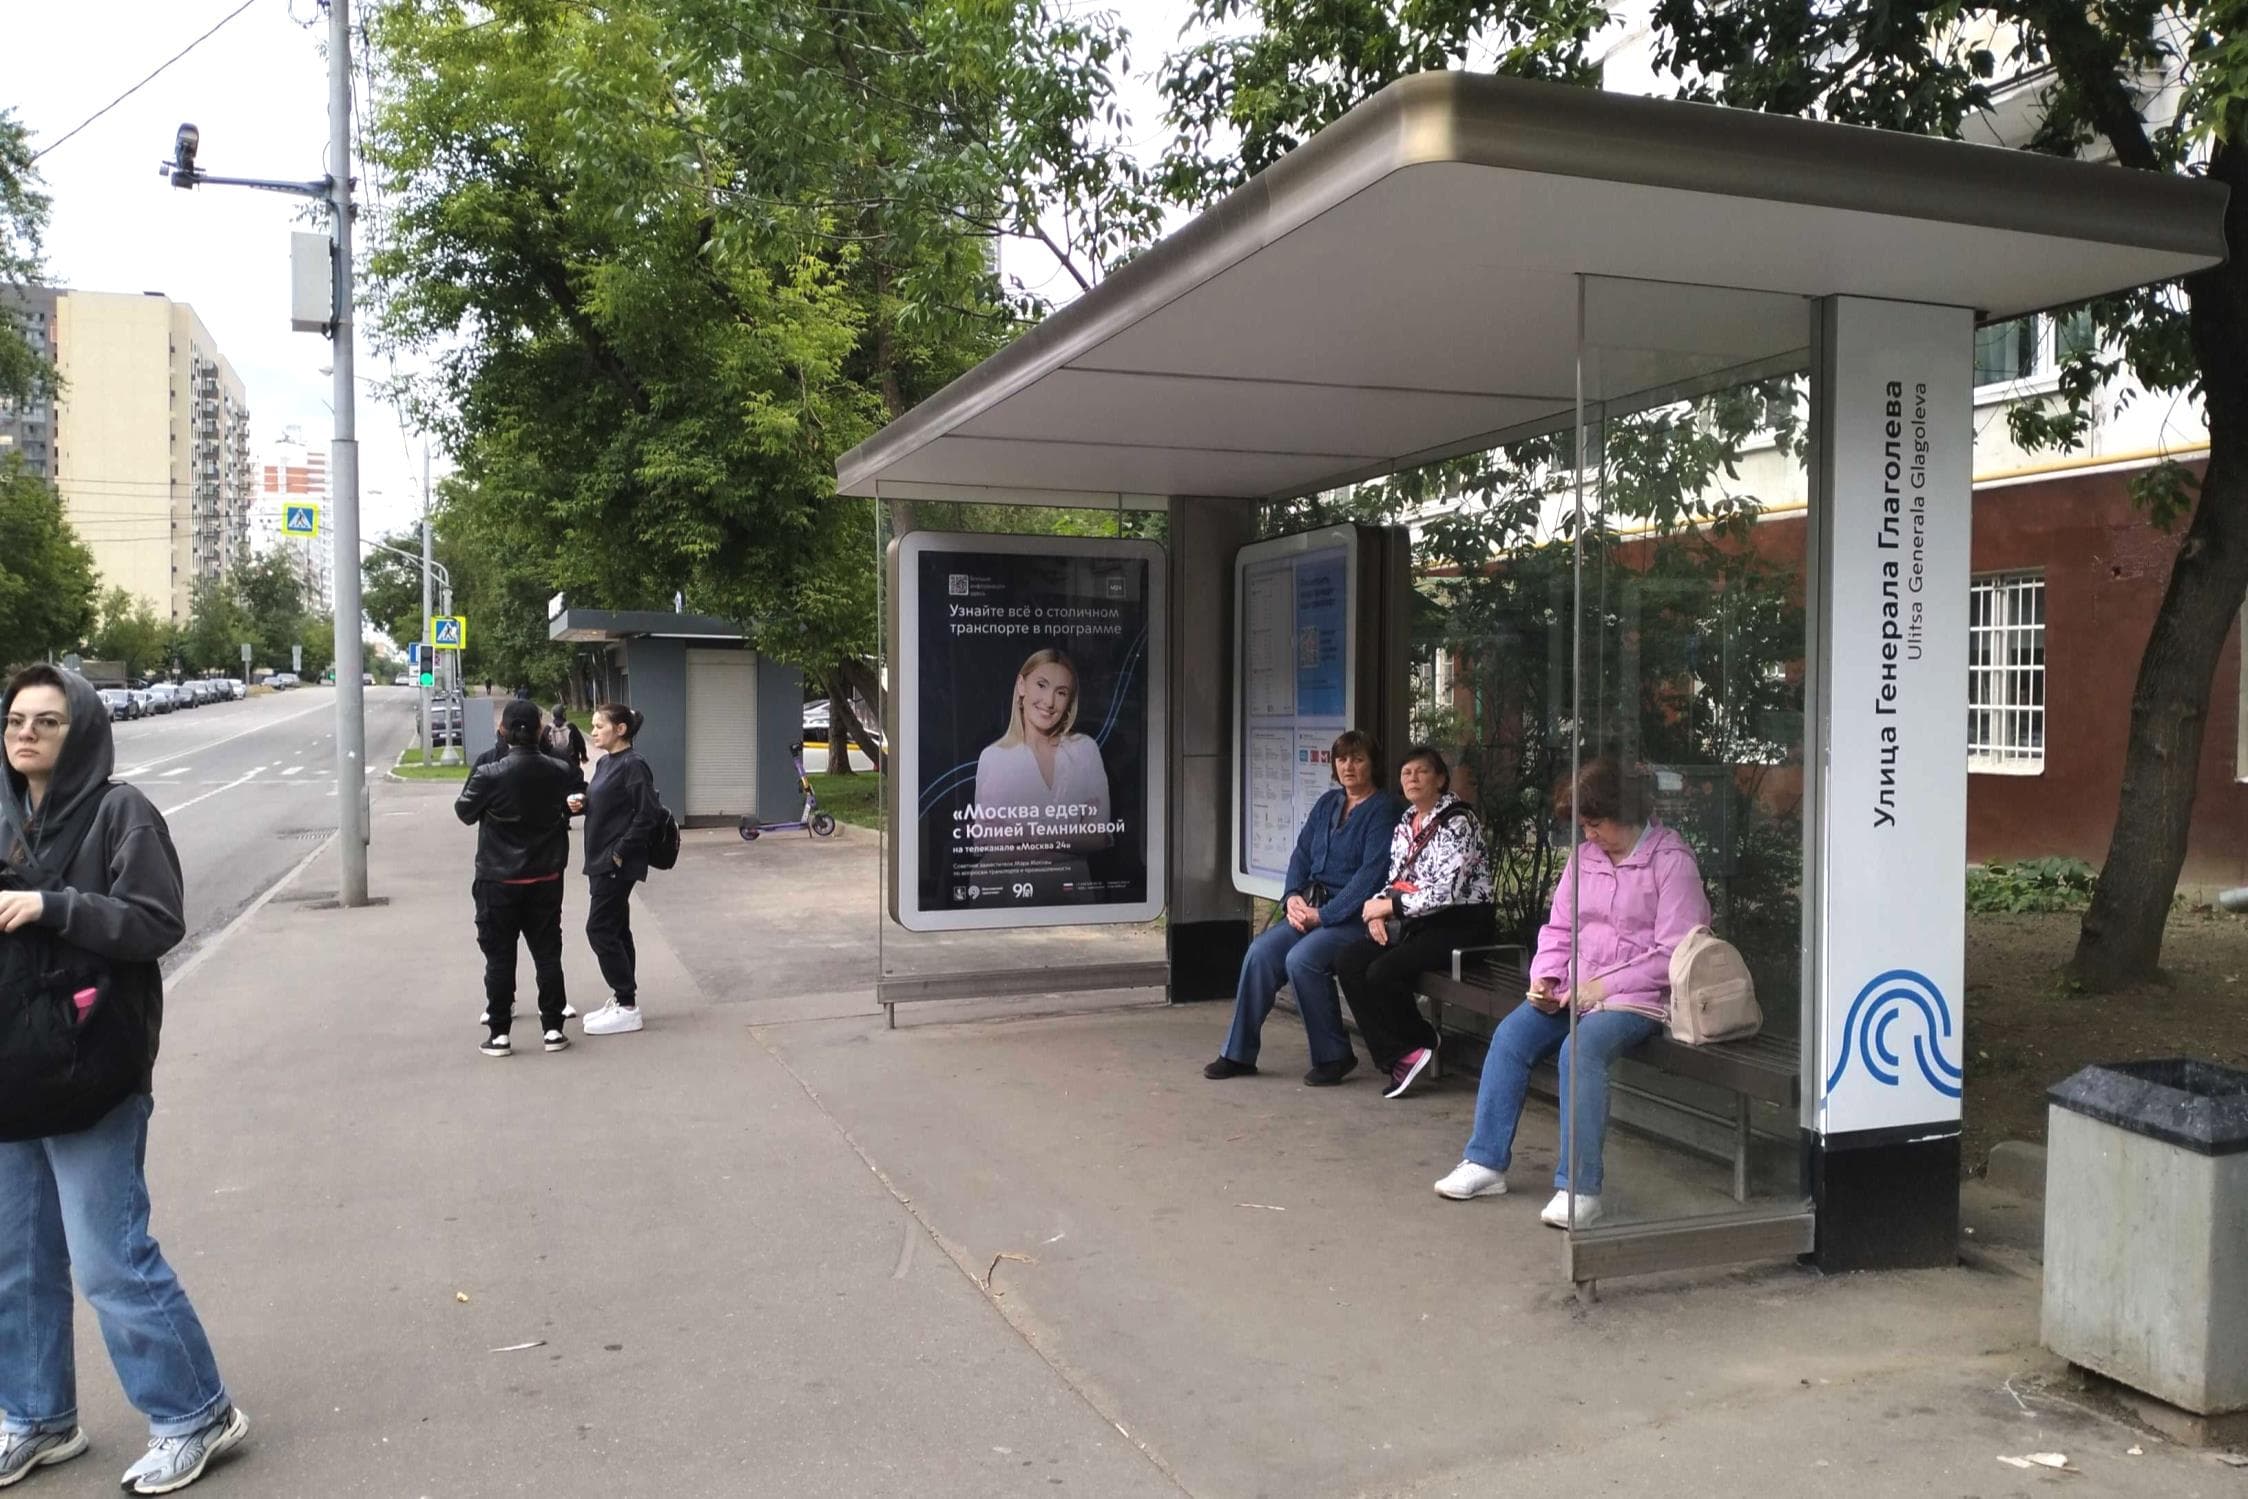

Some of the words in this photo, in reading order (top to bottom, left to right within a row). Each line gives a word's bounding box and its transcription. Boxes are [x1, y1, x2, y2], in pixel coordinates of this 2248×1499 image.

[1878, 380, 1903, 549] Глаголева
[1910, 383, 1929, 489] Glagoleva
[1909, 496, 1926, 593] Generala
[949, 604, 1004, 618] Узнайте
[1008, 605, 1031, 618] всё
[1034, 608, 1043, 618] о
[1047, 608, 1119, 618] столичном
[950, 624, 1029, 637] транспорте
[1033, 625, 1041, 634] в
[1045, 625, 1122, 637] программе
[1876, 561, 1903, 715] Генерала
[1907, 602, 1923, 660] Ulitsa
[1874, 727, 1899, 828] Улица
[953, 804, 1040, 820] «Москва
[1045, 803, 1098, 820] едет»
[953, 828, 962, 839] с
[966, 821, 1024, 839] Юлией
[1028, 820, 1125, 837] Темниковой
[953, 845, 964, 854] на
[965, 844, 1015, 854] телеканале
[1016, 842, 1055, 852] «Москва
[1056, 841, 1071, 851] 24»
